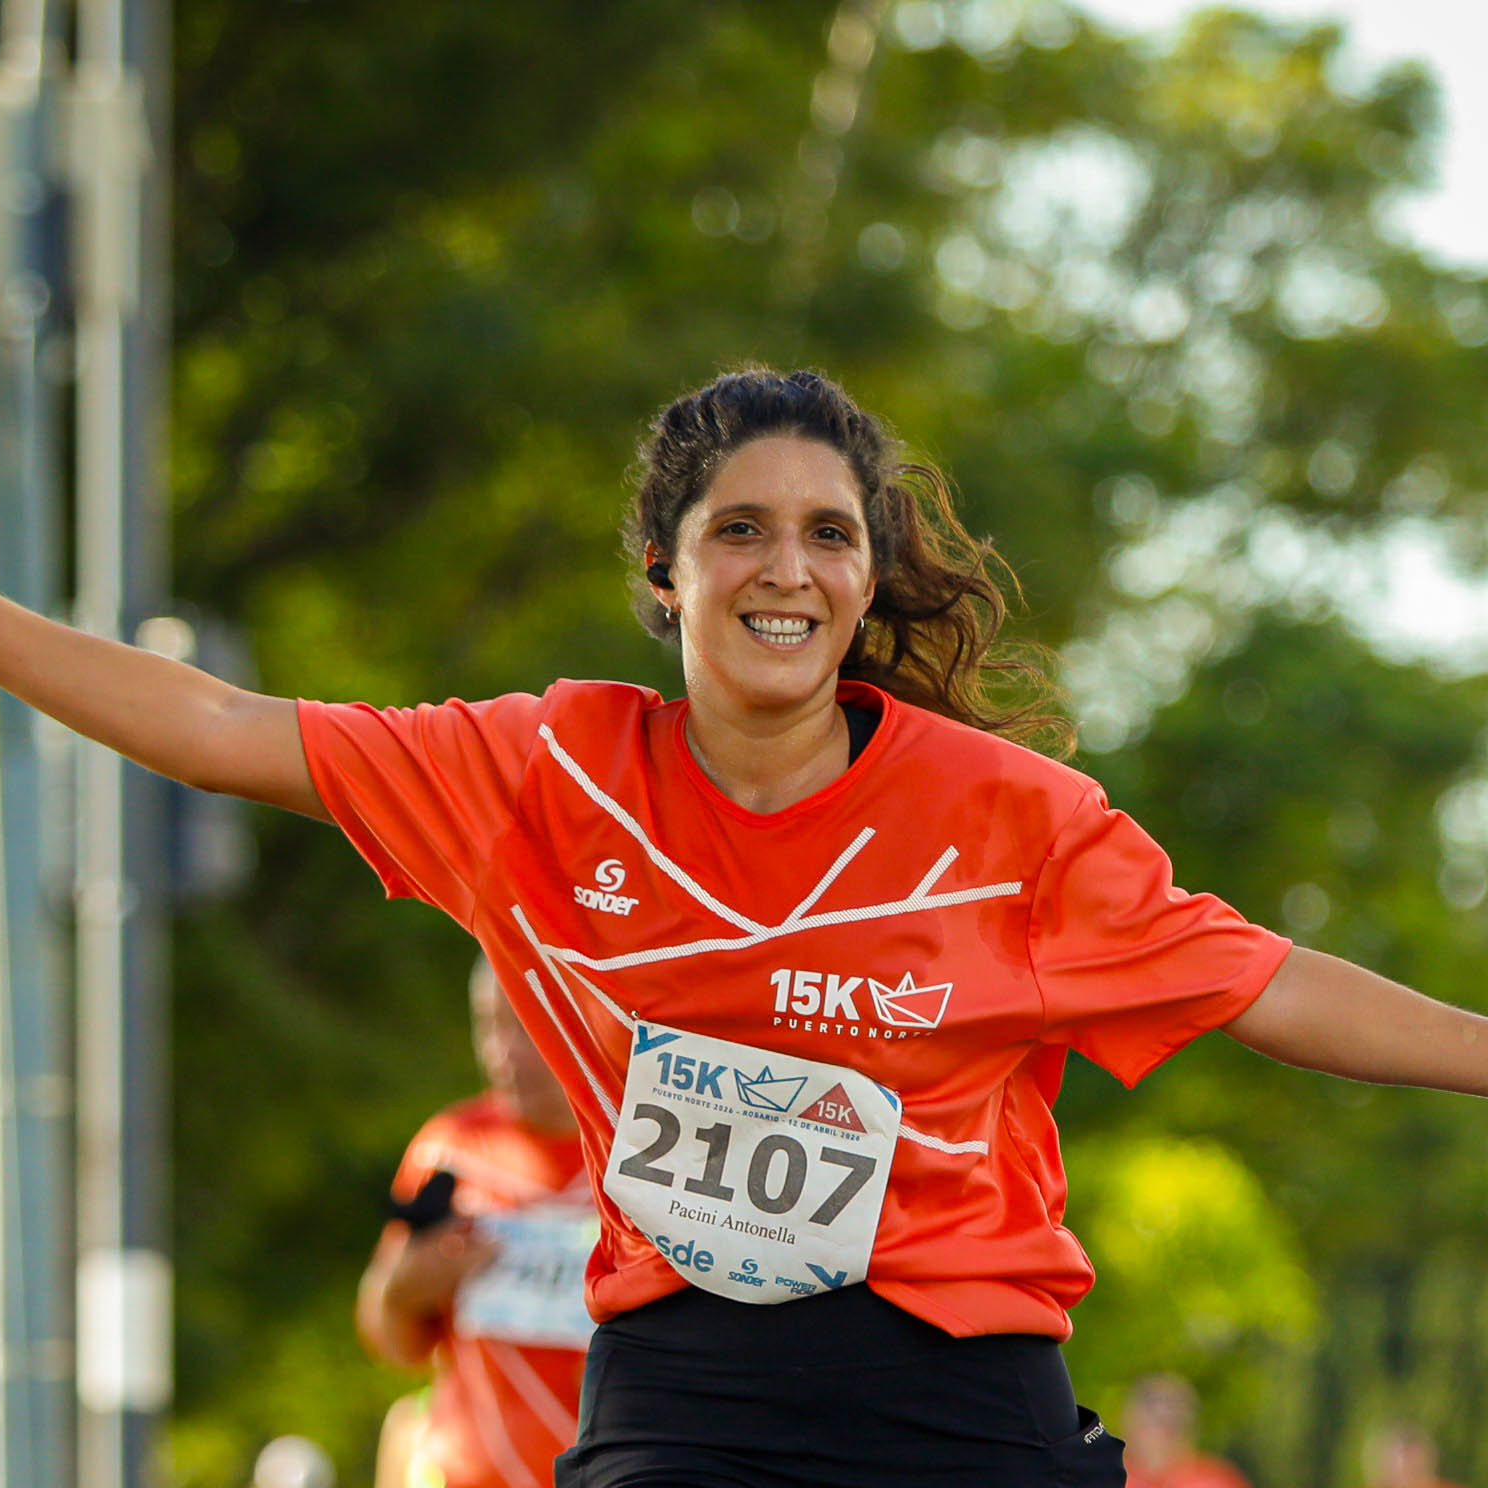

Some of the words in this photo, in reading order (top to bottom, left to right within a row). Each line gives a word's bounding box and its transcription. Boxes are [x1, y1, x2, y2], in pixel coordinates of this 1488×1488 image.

[770, 968, 864, 1020] 15K
[773, 1017, 859, 1037] PUERTO
[868, 1027, 933, 1039] NOR
[656, 1051, 728, 1099] 15K
[652, 1087, 683, 1101] PUERTO
[684, 1096, 711, 1109] NORTE
[742, 1109, 779, 1122] ROSARIO
[800, 1120, 811, 1130] DE
[816, 1100, 852, 1124] 15K
[618, 1103, 878, 1226] 2107
[668, 1199, 718, 1225] Pacini
[720, 1213, 796, 1245] Antonella
[643, 1231, 714, 1273] sde
